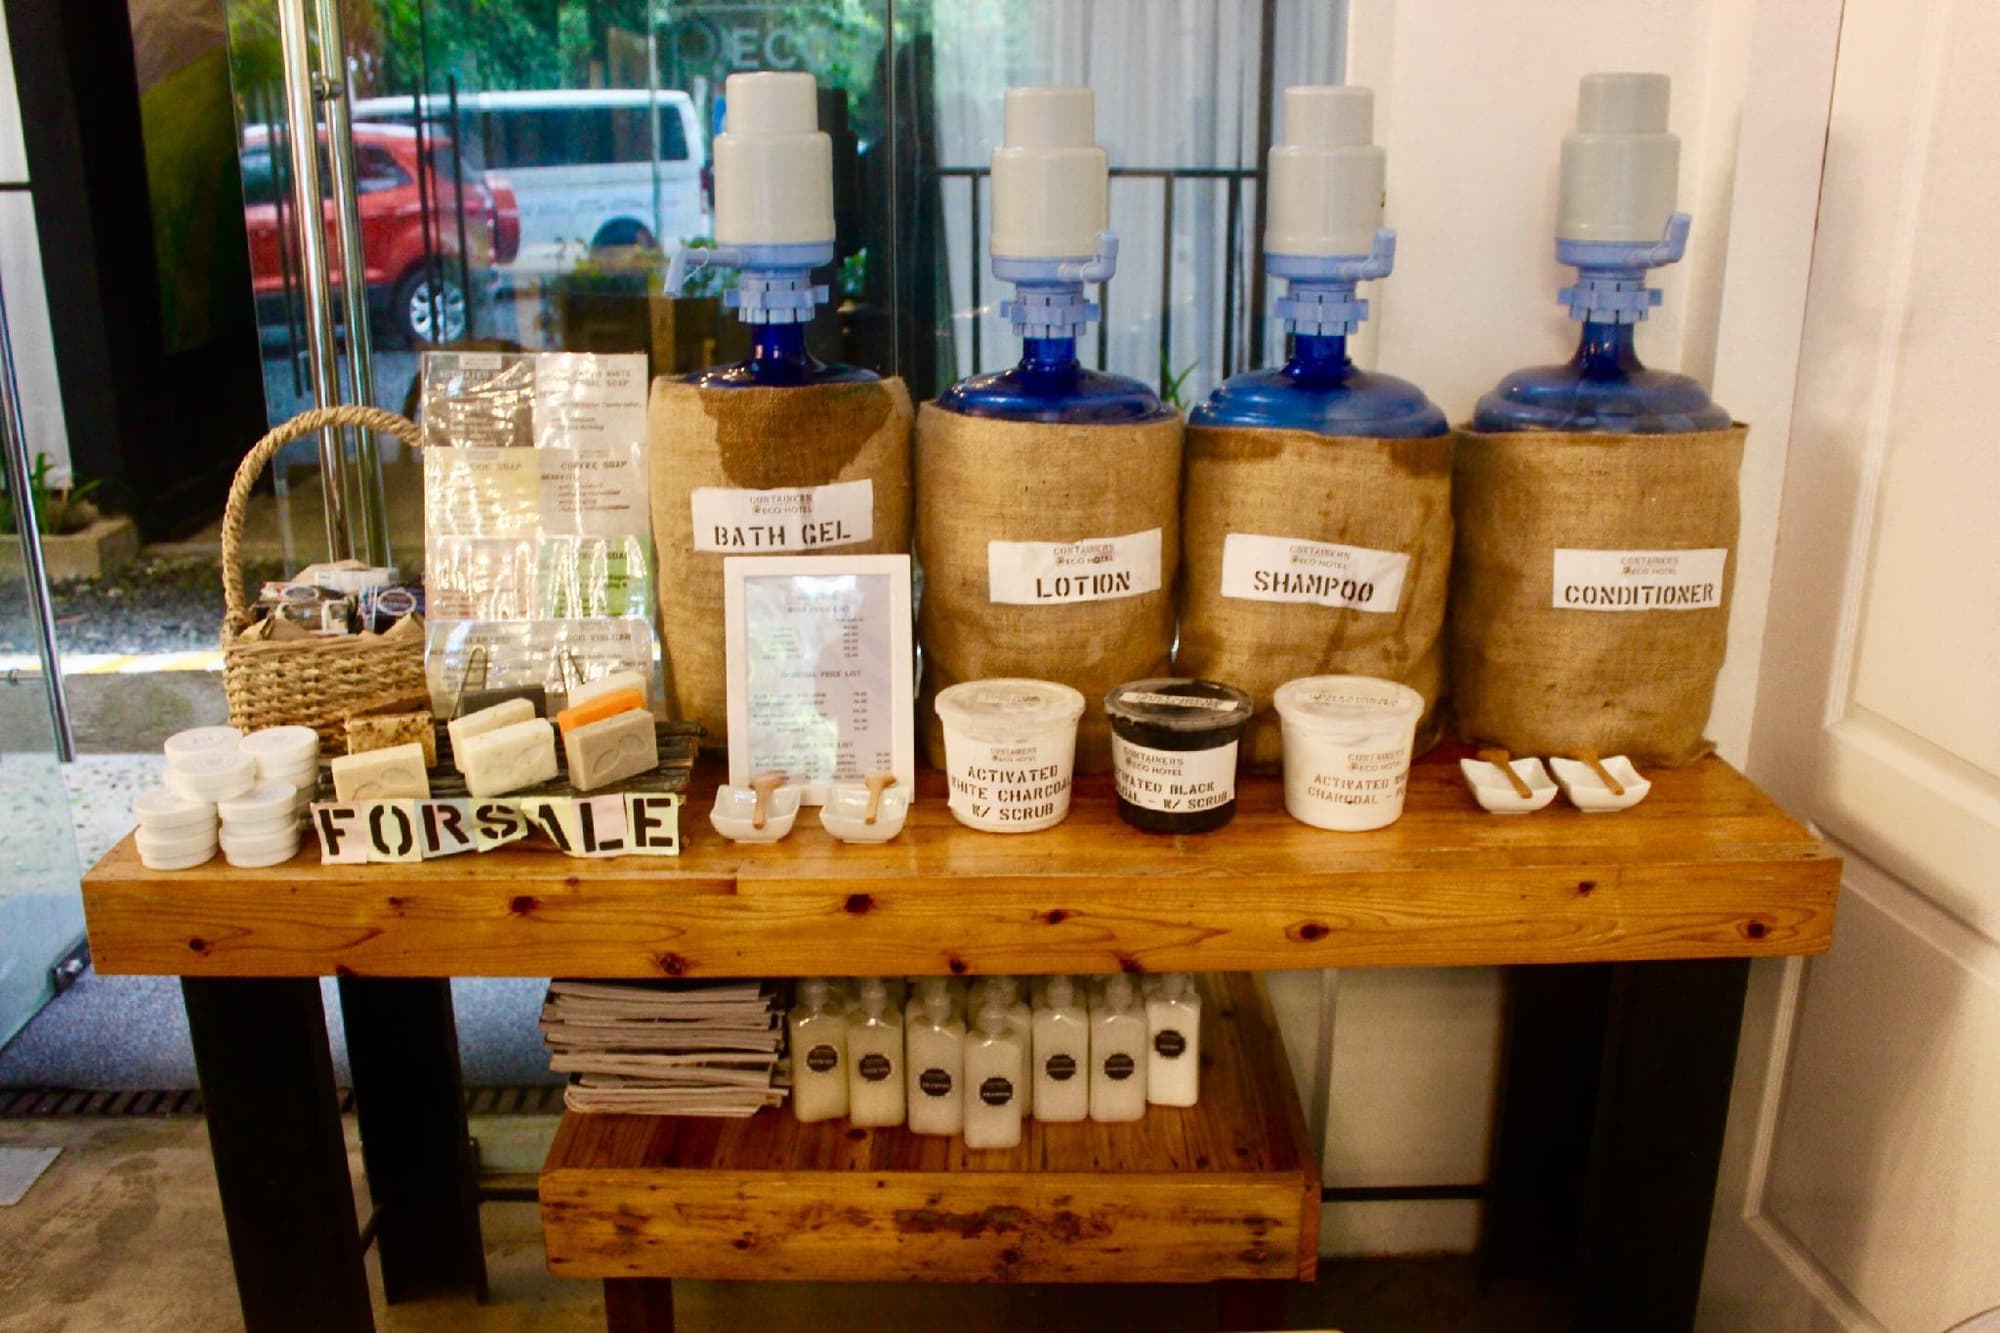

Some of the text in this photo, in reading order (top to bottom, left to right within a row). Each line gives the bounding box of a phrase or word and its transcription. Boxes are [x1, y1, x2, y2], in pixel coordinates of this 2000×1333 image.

[714, 519, 852, 547] BATH GEL
[1036, 570, 1131, 598] LOTION
[1253, 569, 1375, 603] SHAMPOO
[1564, 583, 1714, 606] CONDITIONER
[967, 764, 1058, 784] ACTIVATED
[1152, 765, 1184, 776] HOTEL
[1170, 781, 1215, 796] BLACK
[1313, 773, 1390, 791] ACTIVATED
[1187, 791, 1228, 809] SCRUB
[1307, 786, 1379, 806] CHARCOAL
[999, 802, 1055, 821] SCRUB
[319, 804, 470, 857] FOR
